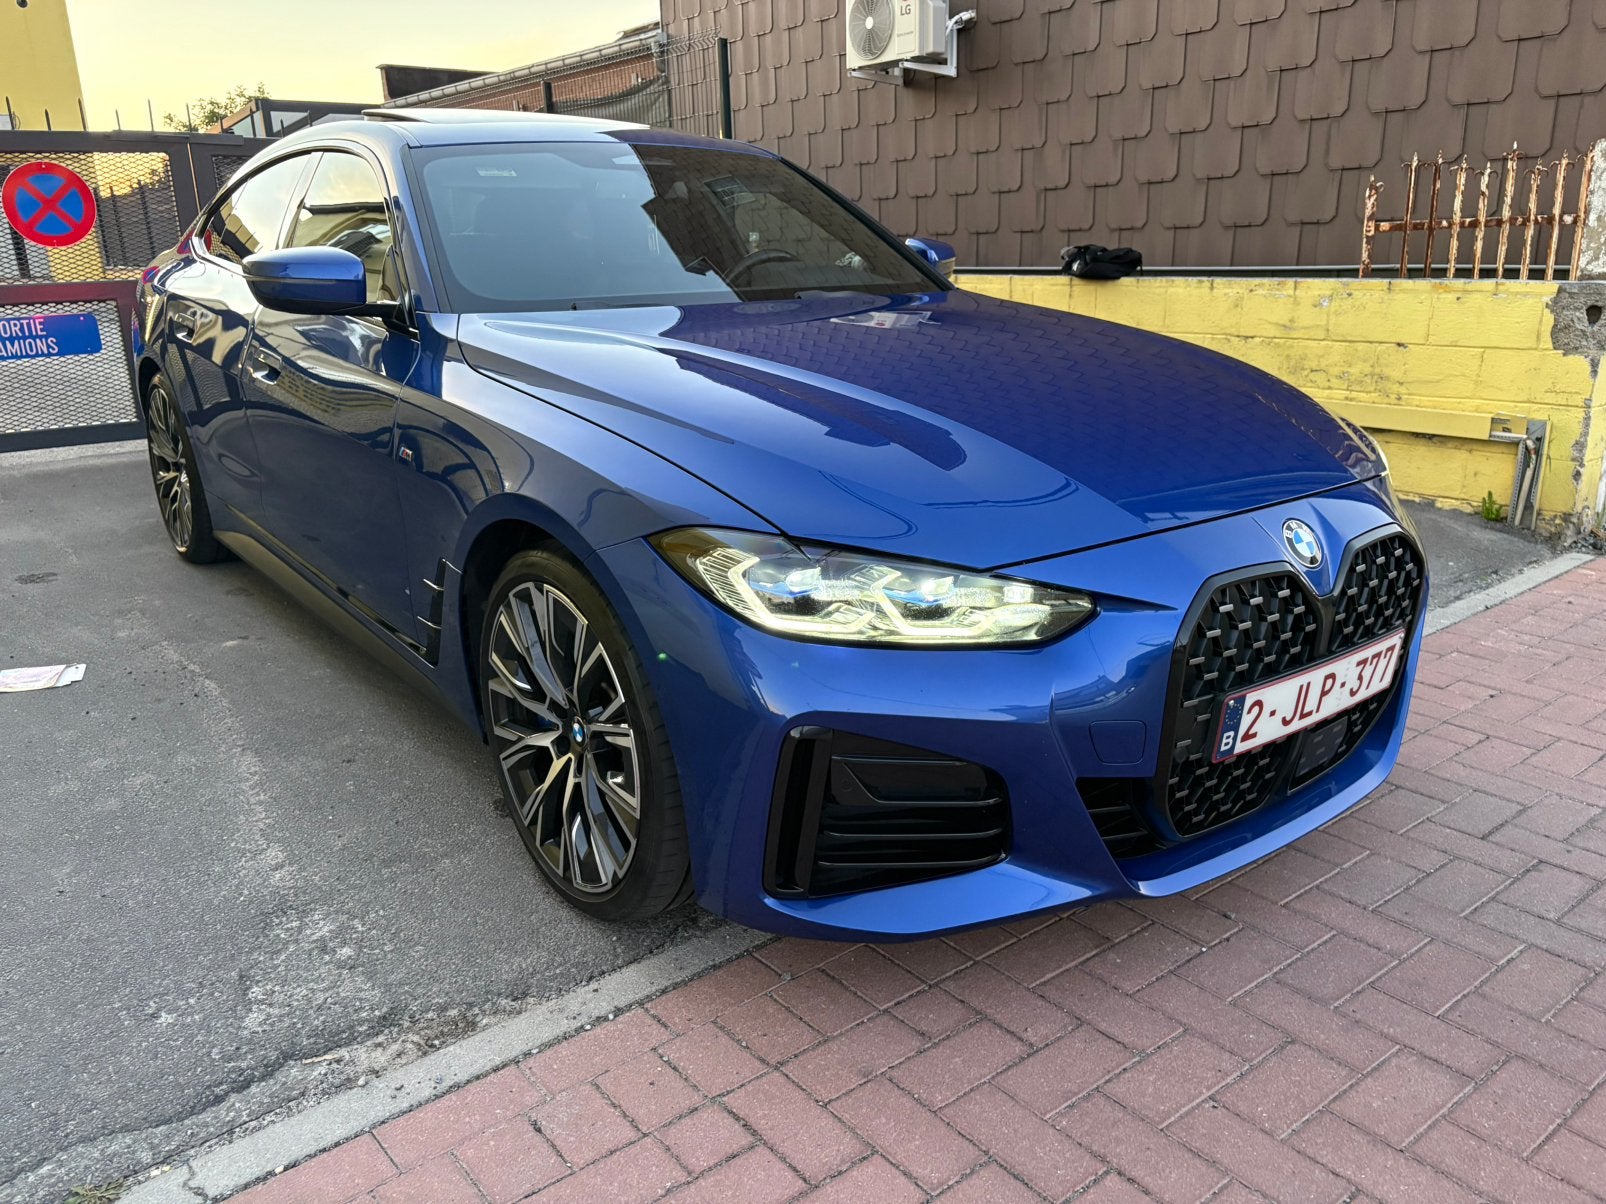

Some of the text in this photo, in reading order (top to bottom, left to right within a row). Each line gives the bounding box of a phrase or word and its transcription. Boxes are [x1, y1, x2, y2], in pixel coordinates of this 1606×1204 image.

[900, 4, 911, 16] LG
[0, 319, 47, 337] ORTIE
[1240, 643, 1397, 744] 2-JLP-377
[1220, 730, 1235, 752] B
